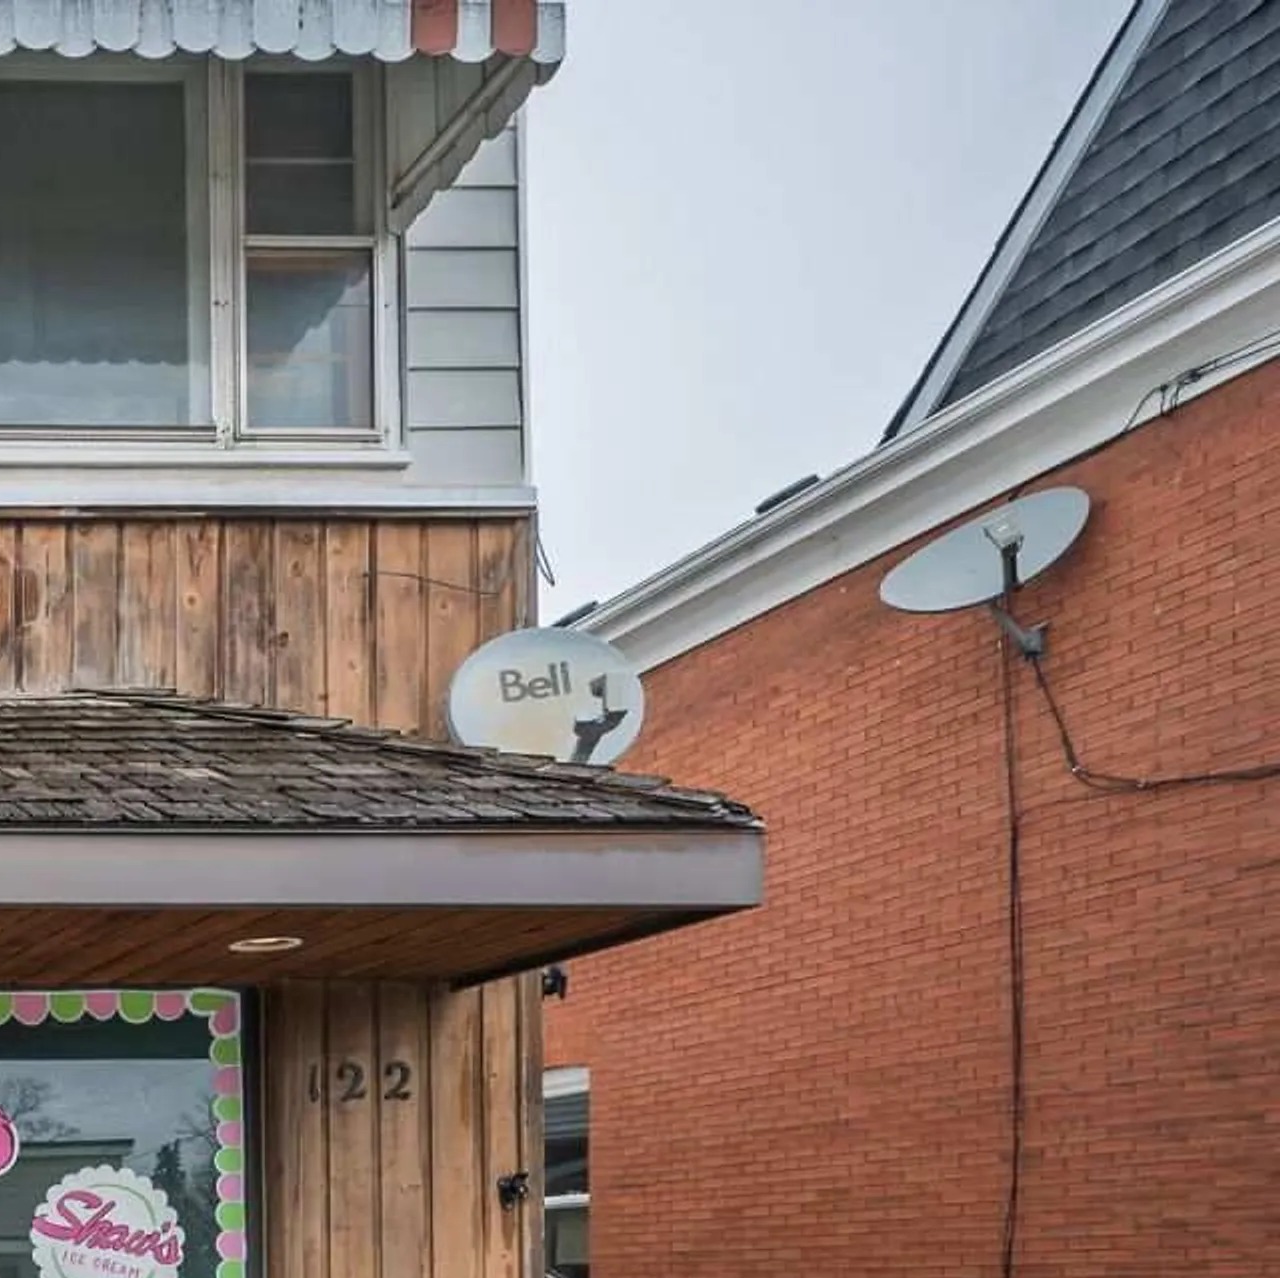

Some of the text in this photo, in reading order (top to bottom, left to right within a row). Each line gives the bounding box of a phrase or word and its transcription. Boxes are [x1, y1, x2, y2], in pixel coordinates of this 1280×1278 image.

[499, 661, 572, 703] Bell
[309, 1061, 412, 1103] 122
[62, 1250, 86, 1266] ICE
